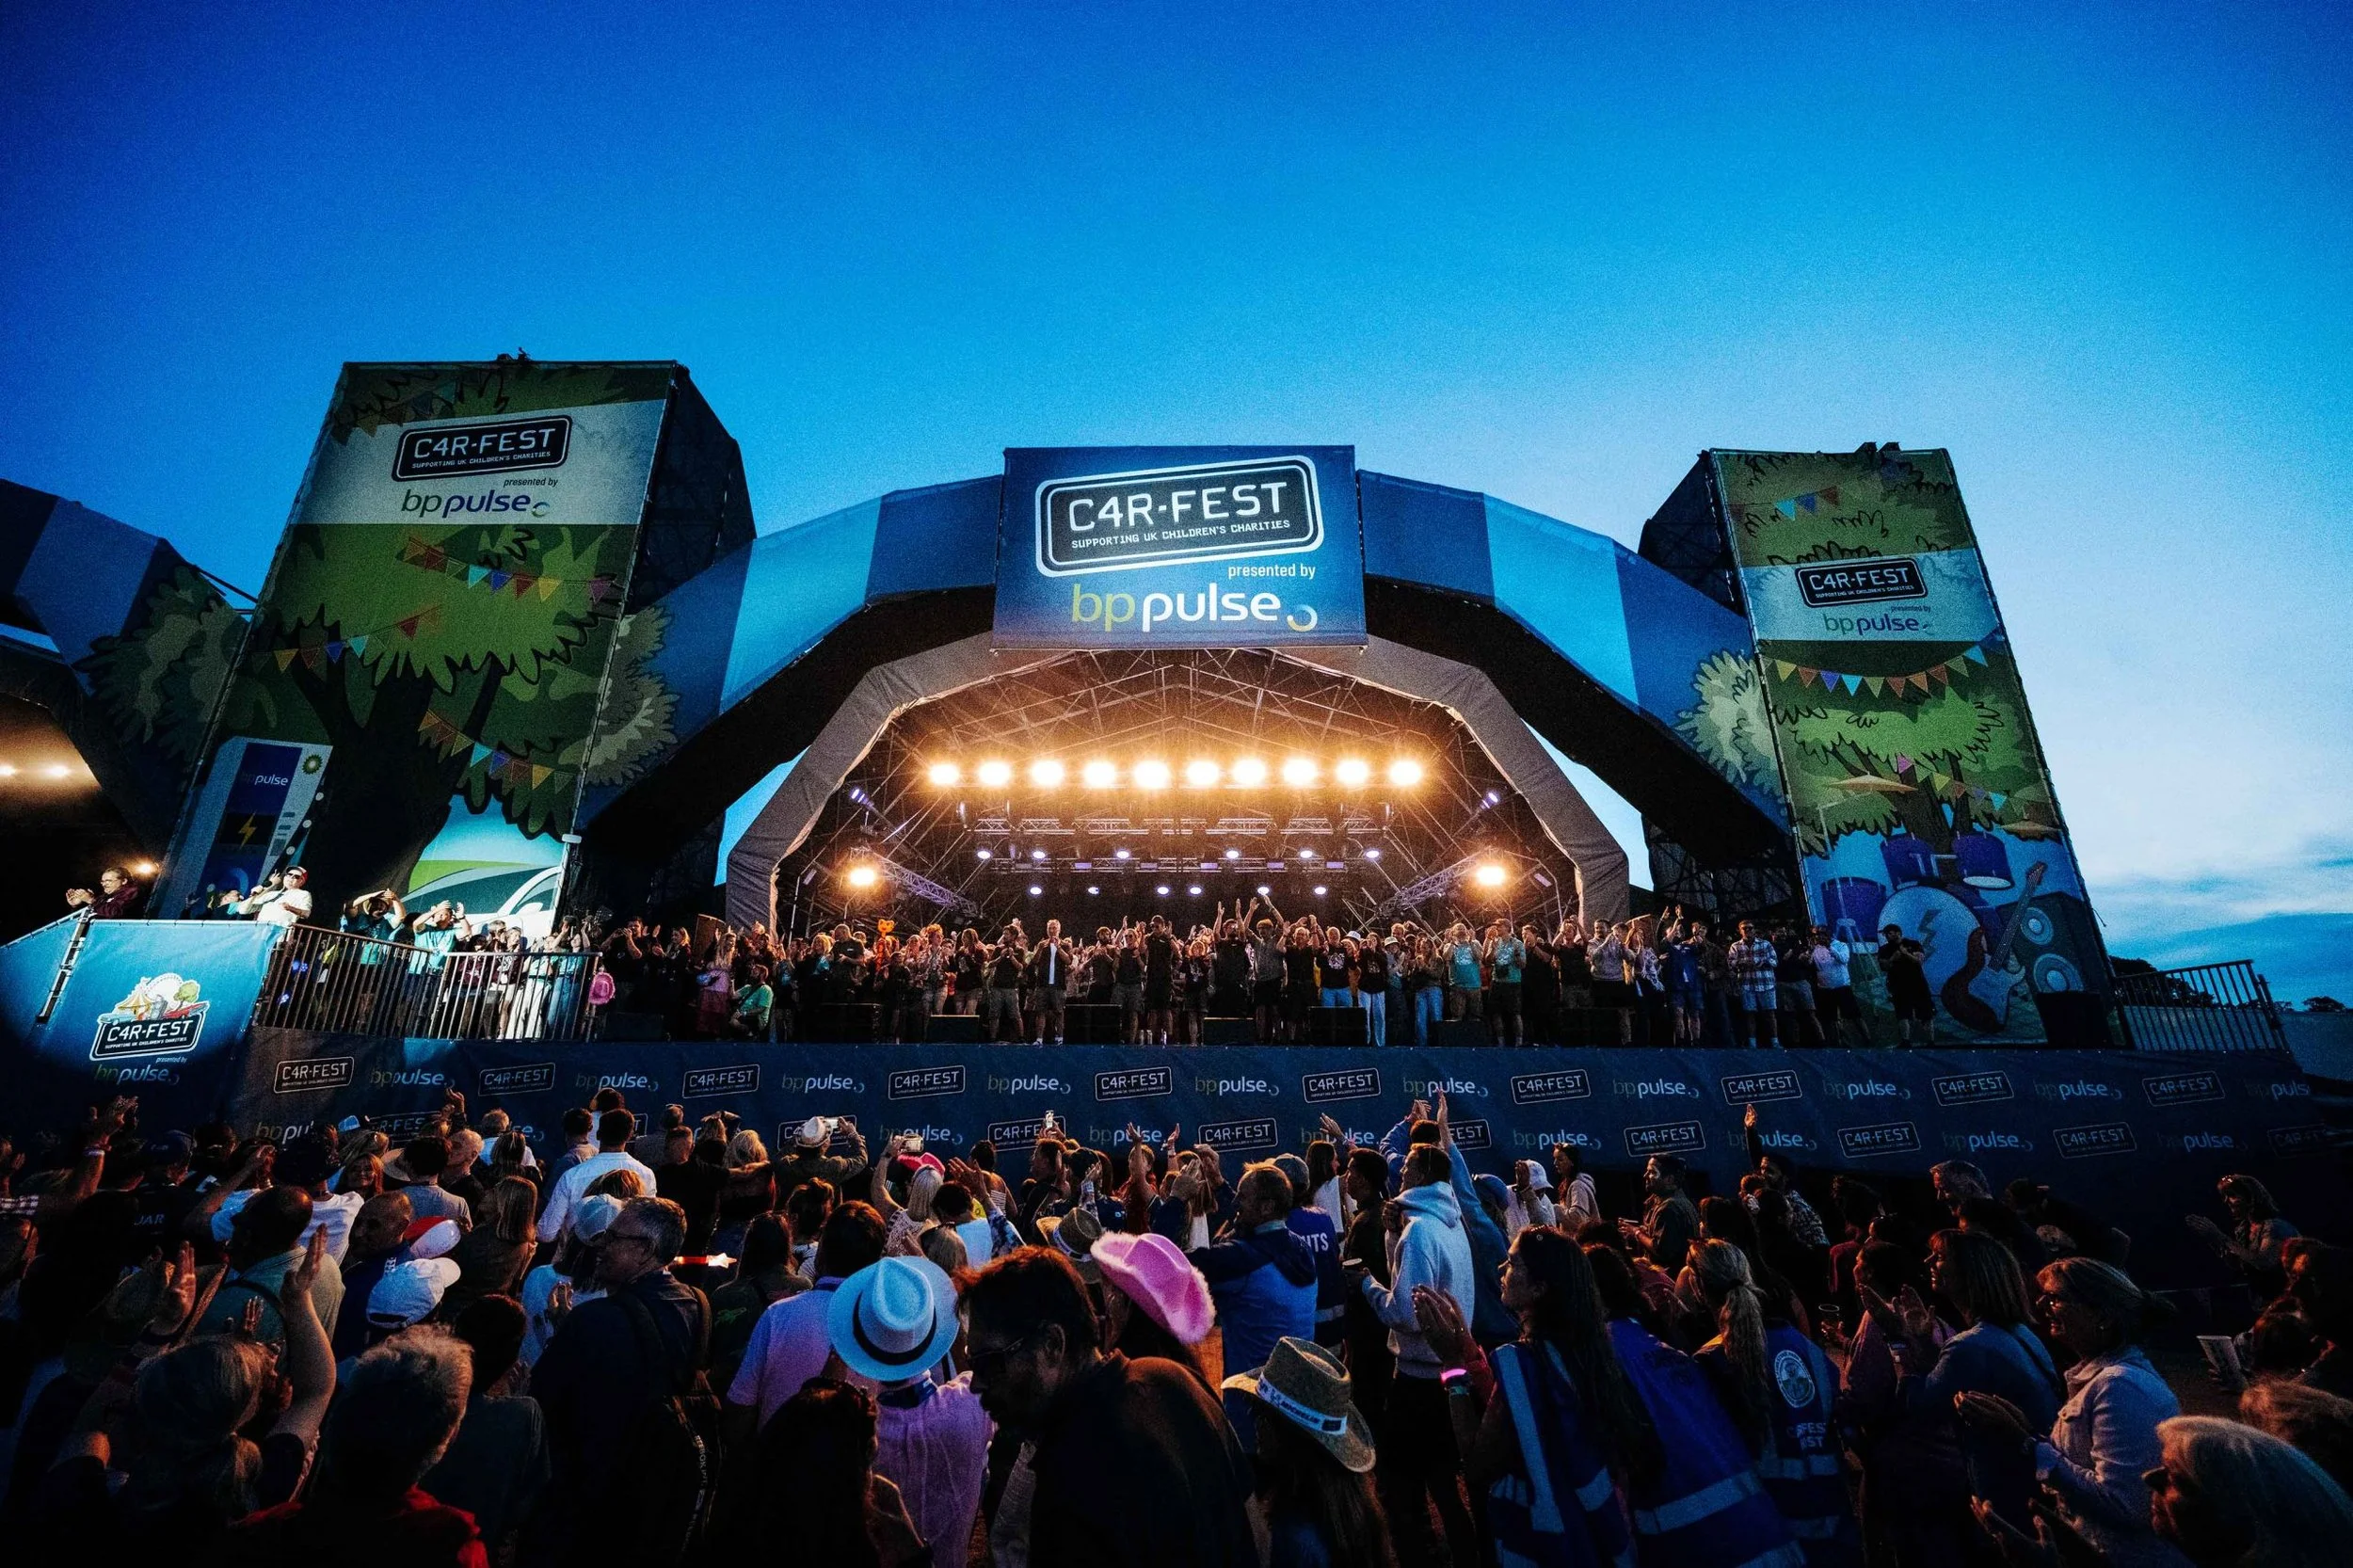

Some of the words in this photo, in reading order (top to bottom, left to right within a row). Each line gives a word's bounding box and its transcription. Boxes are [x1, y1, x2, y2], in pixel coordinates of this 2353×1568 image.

[411, 459, 456, 469] SUPPORTING
[469, 454, 510, 464] CHILDREN'S
[513, 450, 551, 460] CHARITIES
[503, 477, 545, 488] presented
[547, 477, 558, 488] by
[1071, 534, 1140, 549] SUPPORTING
[1144, 531, 1158, 541] UK
[1161, 525, 1226, 539] CHILDREN'S
[1230, 520, 1290, 534] CHARITIES
[1228, 564, 1296, 579] presented
[1300, 564, 1316, 579] by
[155, 1056, 181, 1064] presented
